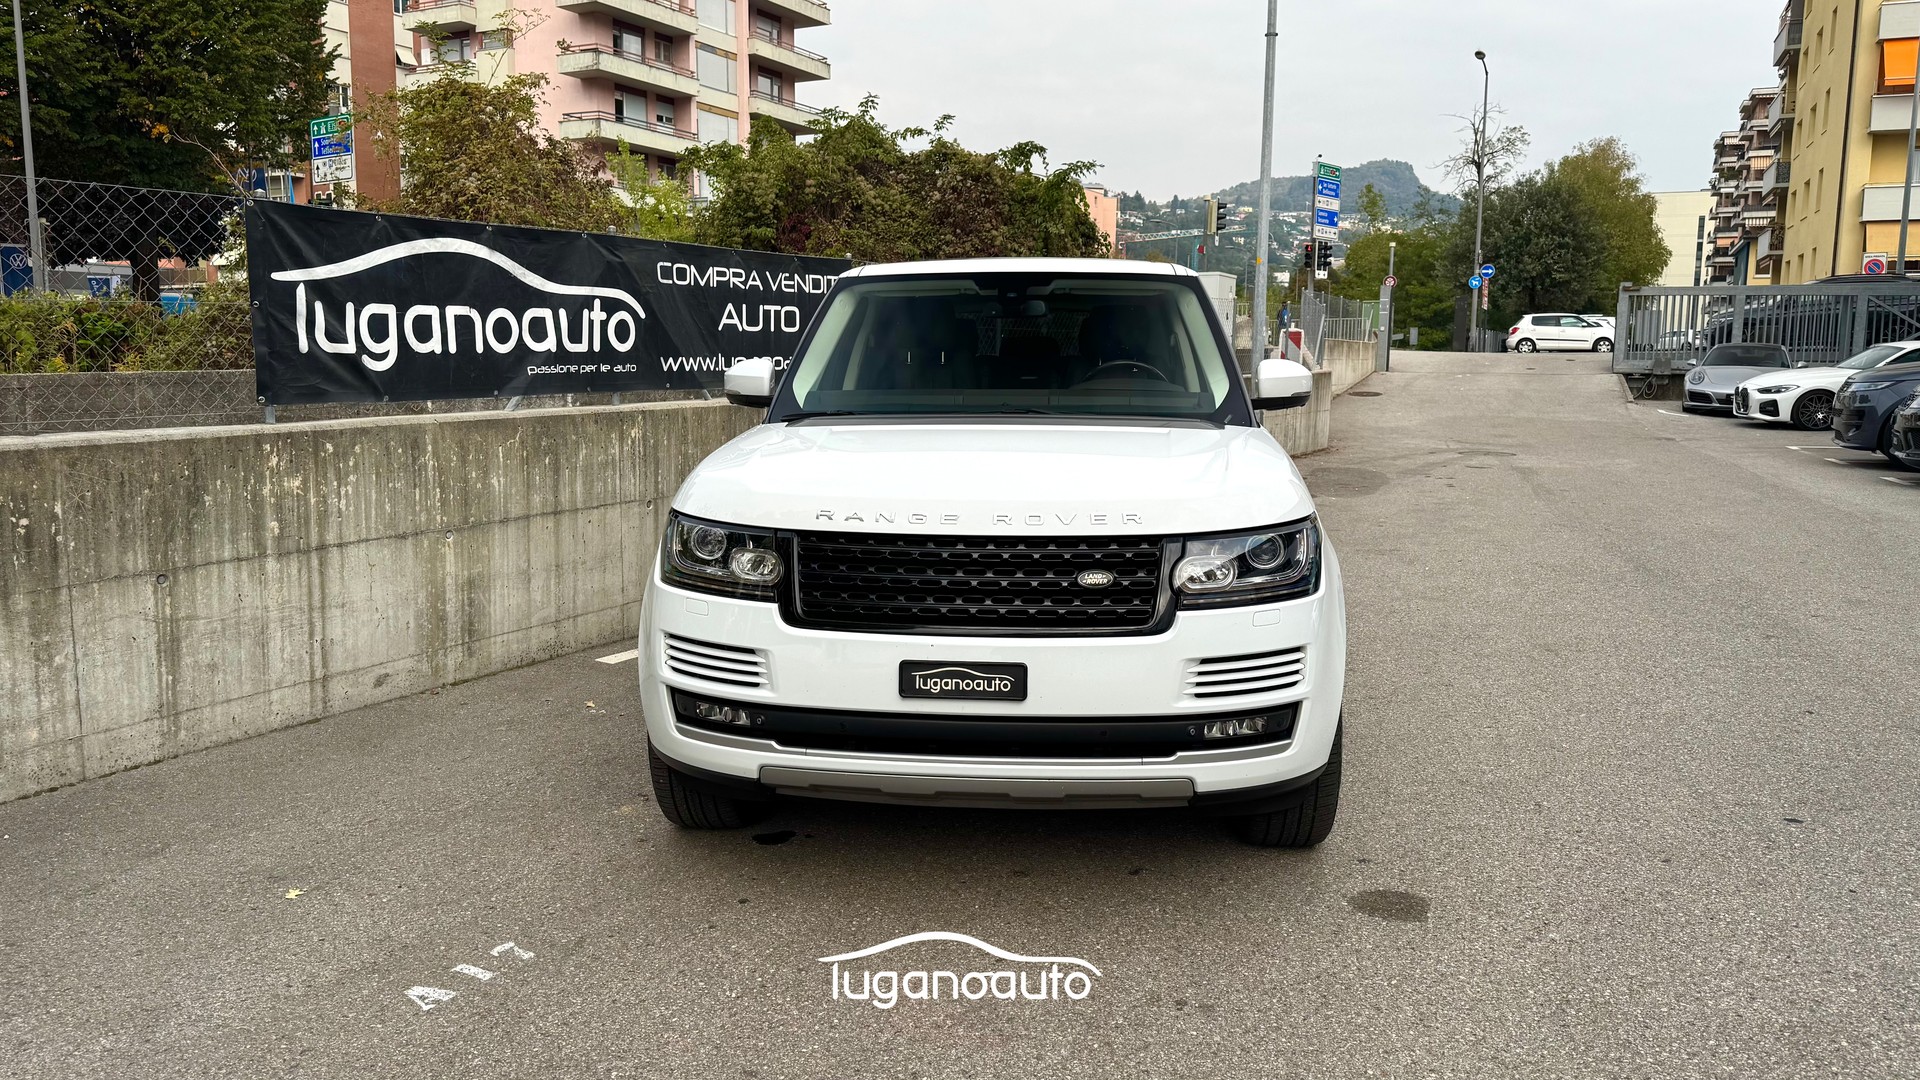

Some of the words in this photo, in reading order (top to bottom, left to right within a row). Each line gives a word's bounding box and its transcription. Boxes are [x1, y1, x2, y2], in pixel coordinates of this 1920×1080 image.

[656, 261, 763, 291] COMPRA
[295, 281, 636, 372] luganoauto
[717, 302, 800, 332] AUTO
[579, 364, 598, 374] per
[600, 363, 611, 373] le
[613, 363, 637, 373] auto
[815, 509, 961, 526] RANGE
[992, 512, 1144, 527] ROVER
[915, 674, 1011, 693] luganoauto
